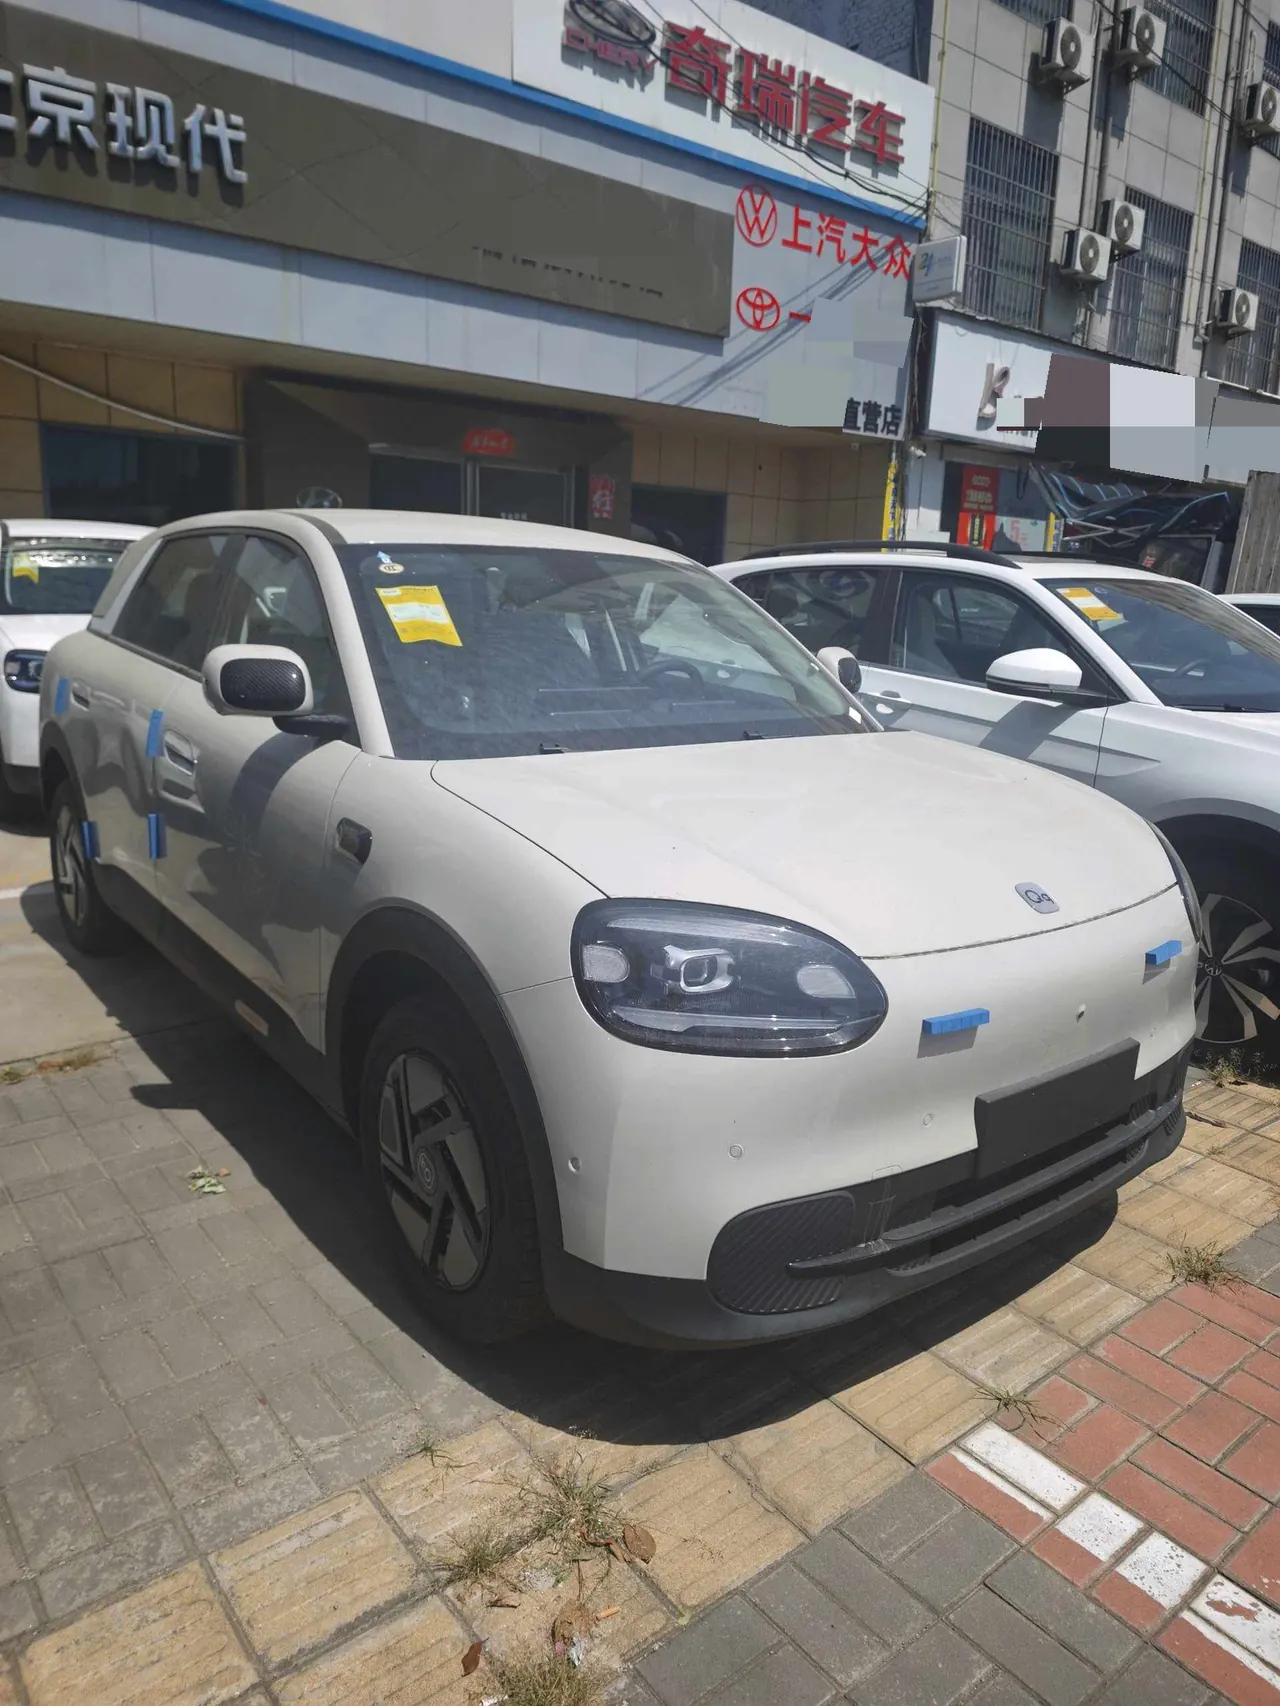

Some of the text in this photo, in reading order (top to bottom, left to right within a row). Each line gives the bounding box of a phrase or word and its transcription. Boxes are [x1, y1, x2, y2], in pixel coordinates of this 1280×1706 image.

[565, 28, 659, 73] CHERY
[0, 63, 248, 184] 京现代
[662, 20, 906, 165] 奇瑞汽车
[781, 203, 912, 283] 上汽大众
[843, 397, 902, 437] 直营店
